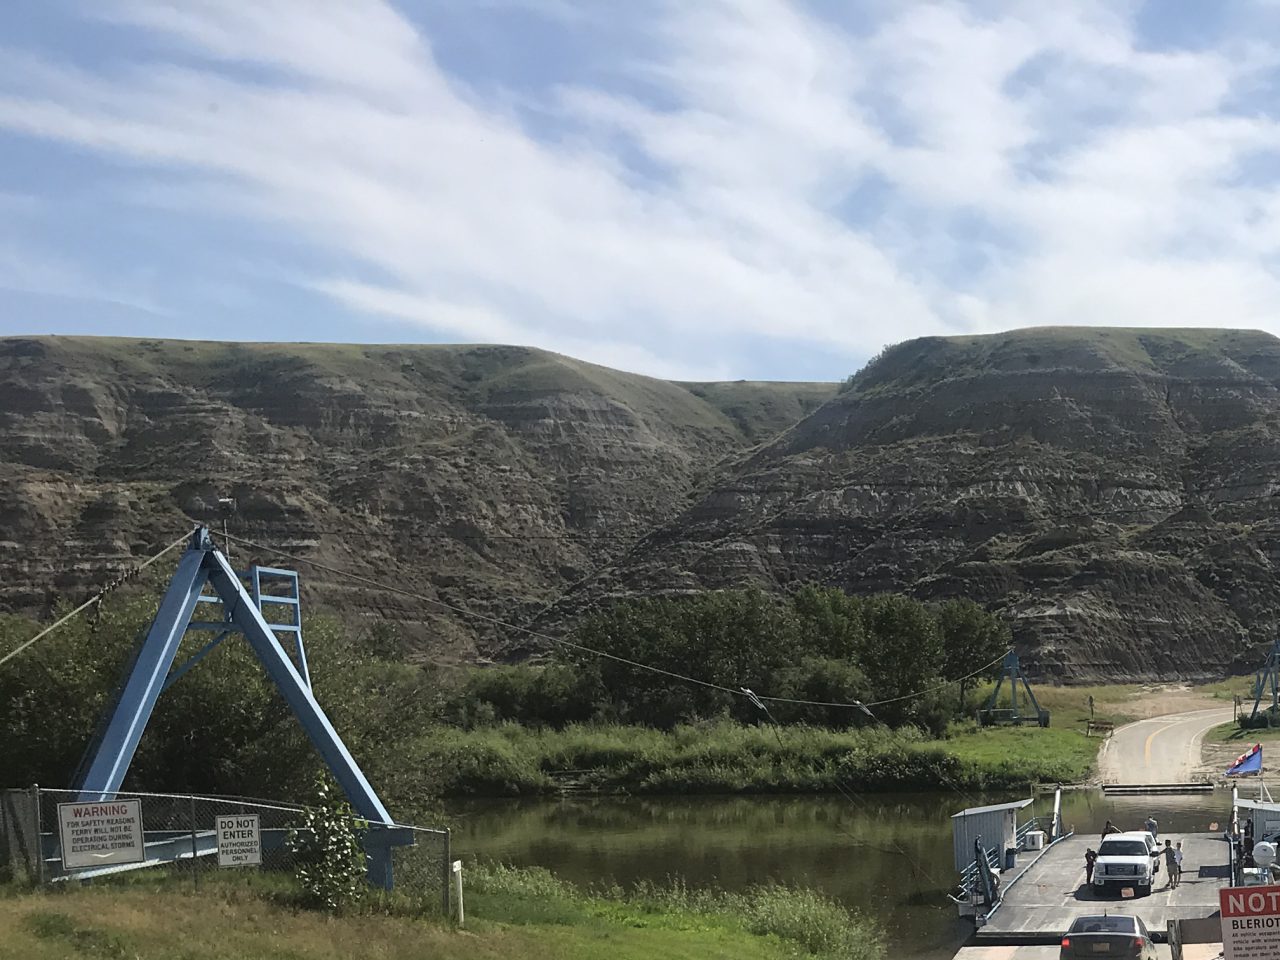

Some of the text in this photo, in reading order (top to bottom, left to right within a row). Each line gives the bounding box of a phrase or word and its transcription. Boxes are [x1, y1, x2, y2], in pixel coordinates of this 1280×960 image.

[72, 804, 128, 818] WARNING
[221, 820, 255, 829] DO NOT
[223, 830, 253, 839] ENTER
[1232, 918, 1280, 929] BLERIOT
